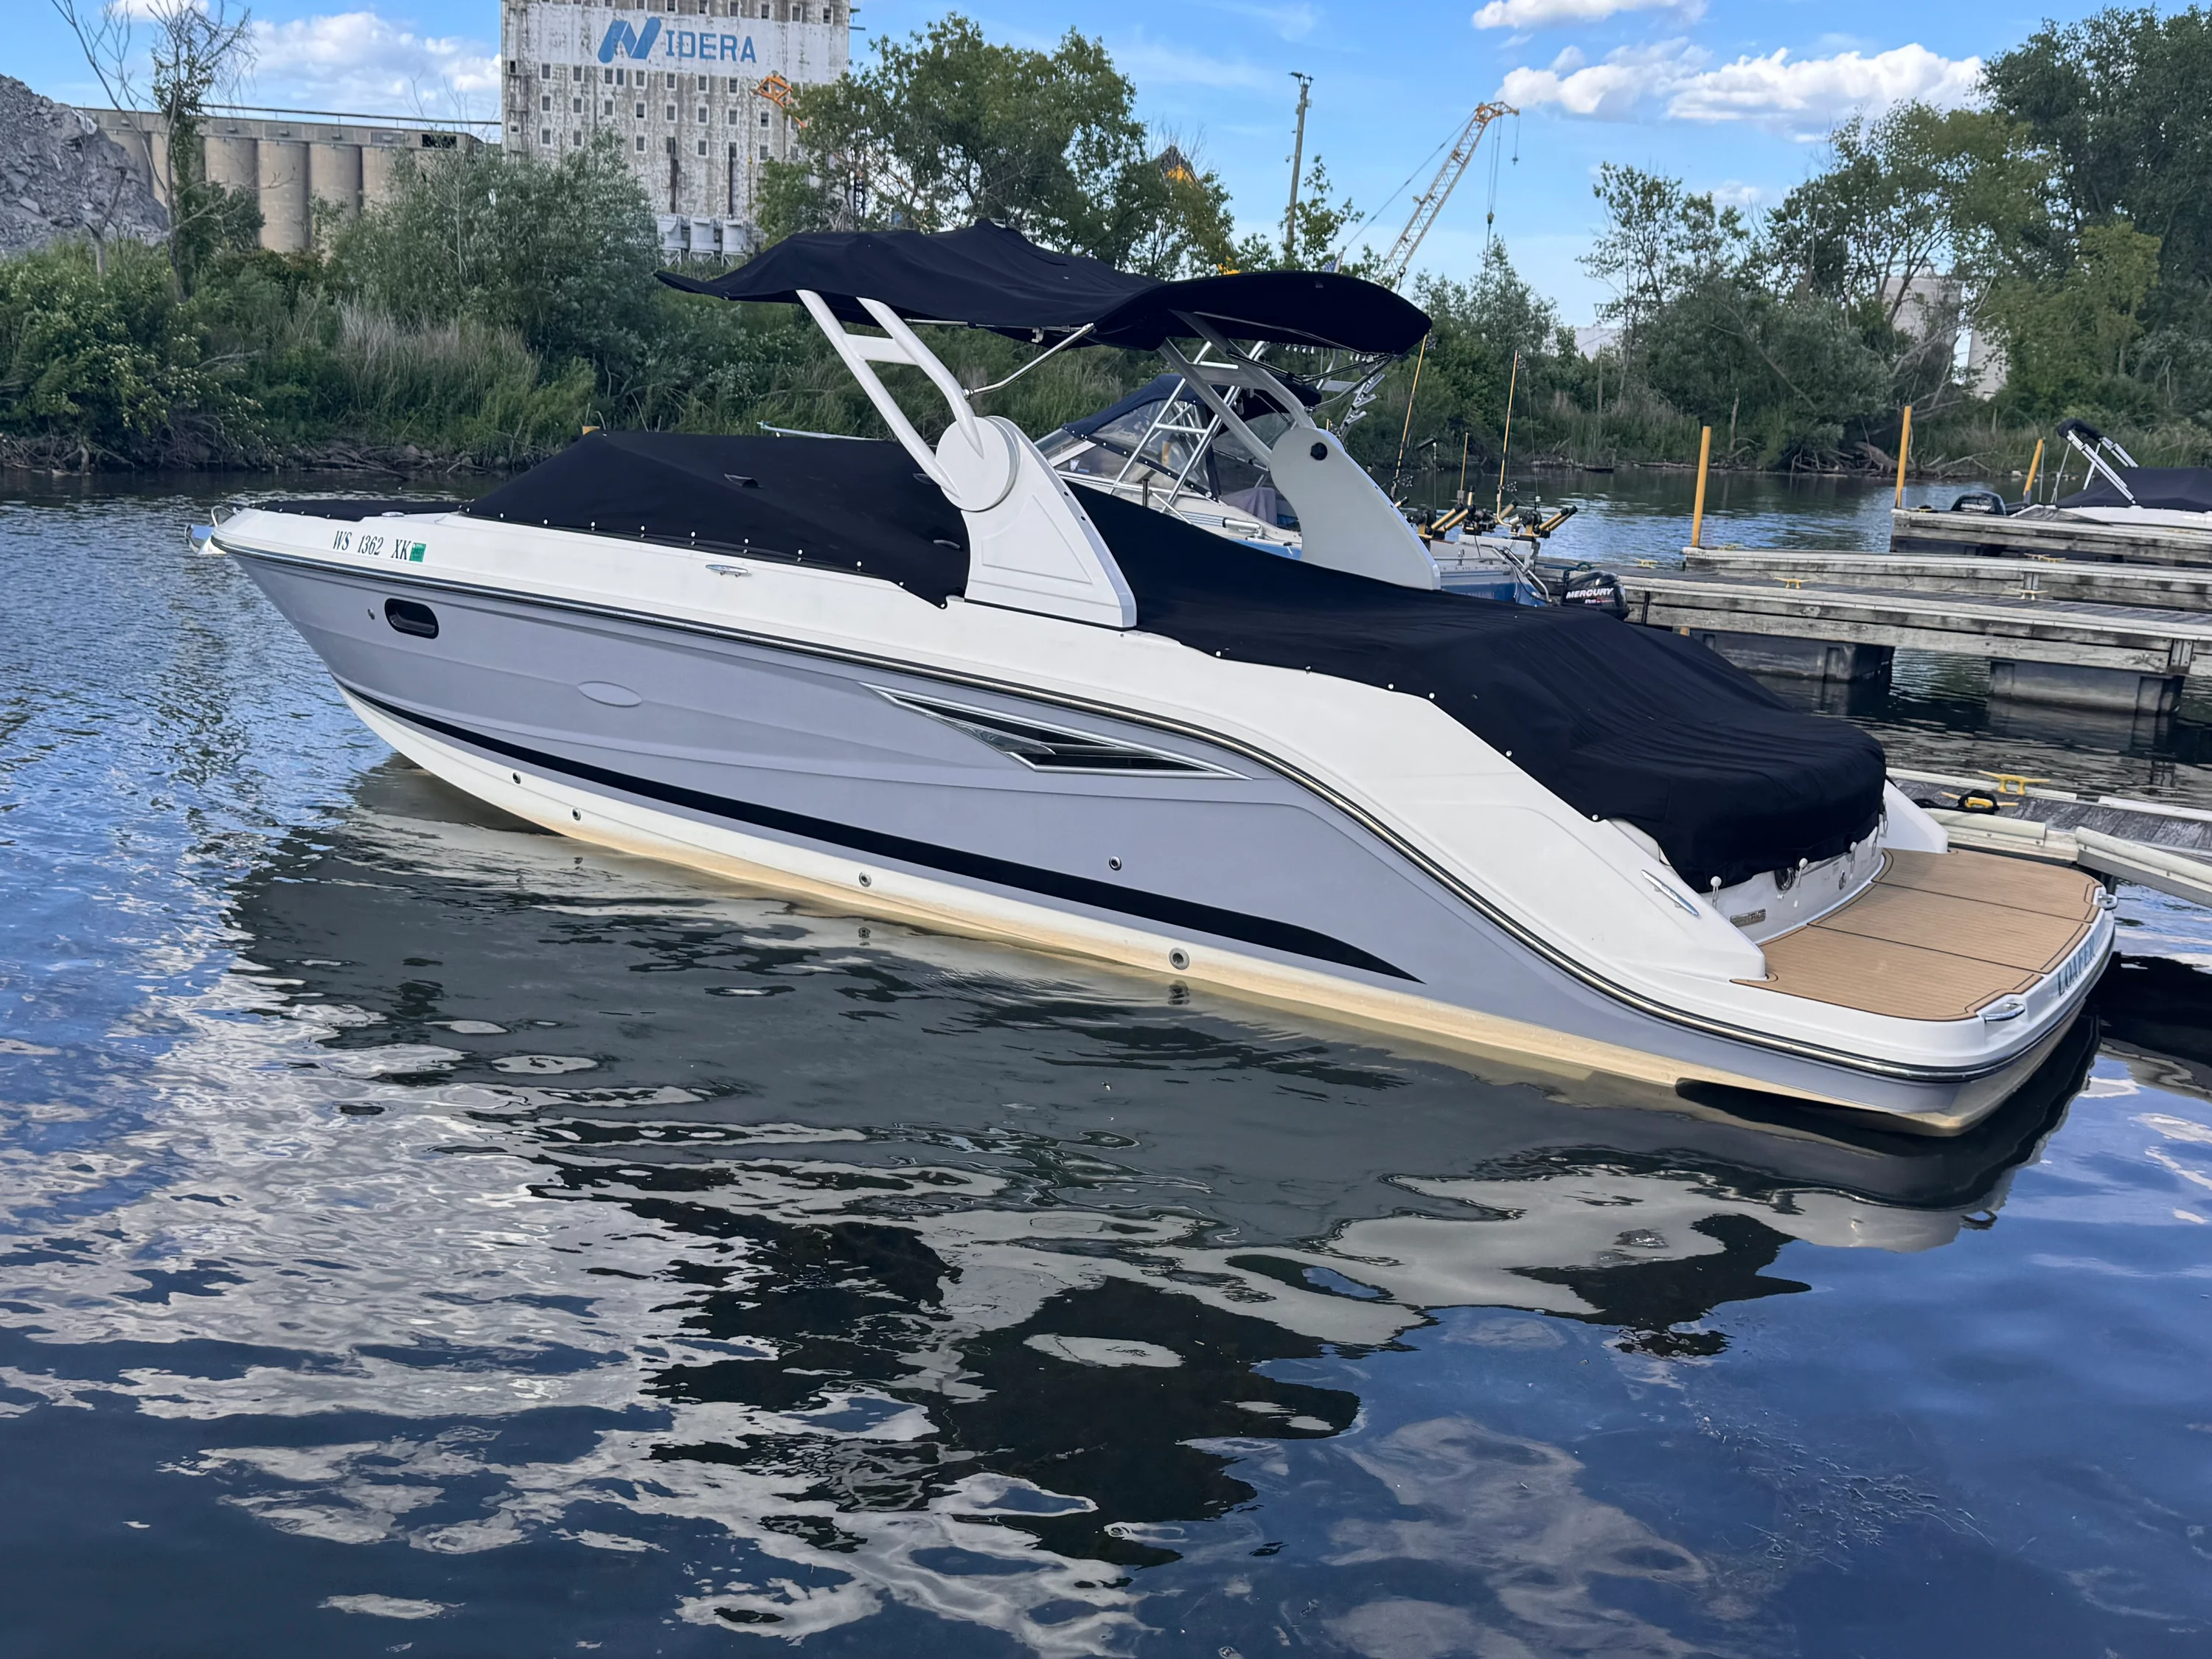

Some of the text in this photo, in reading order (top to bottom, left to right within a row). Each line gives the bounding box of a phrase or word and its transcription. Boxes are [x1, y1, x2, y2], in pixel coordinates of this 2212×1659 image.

[333, 530, 352, 551] WS
[357, 535, 384, 556] 1362
[391, 538, 411, 560] XK
[1565, 588, 1614, 599] MERCURY
[2057, 934, 2096, 997] LOAFER
